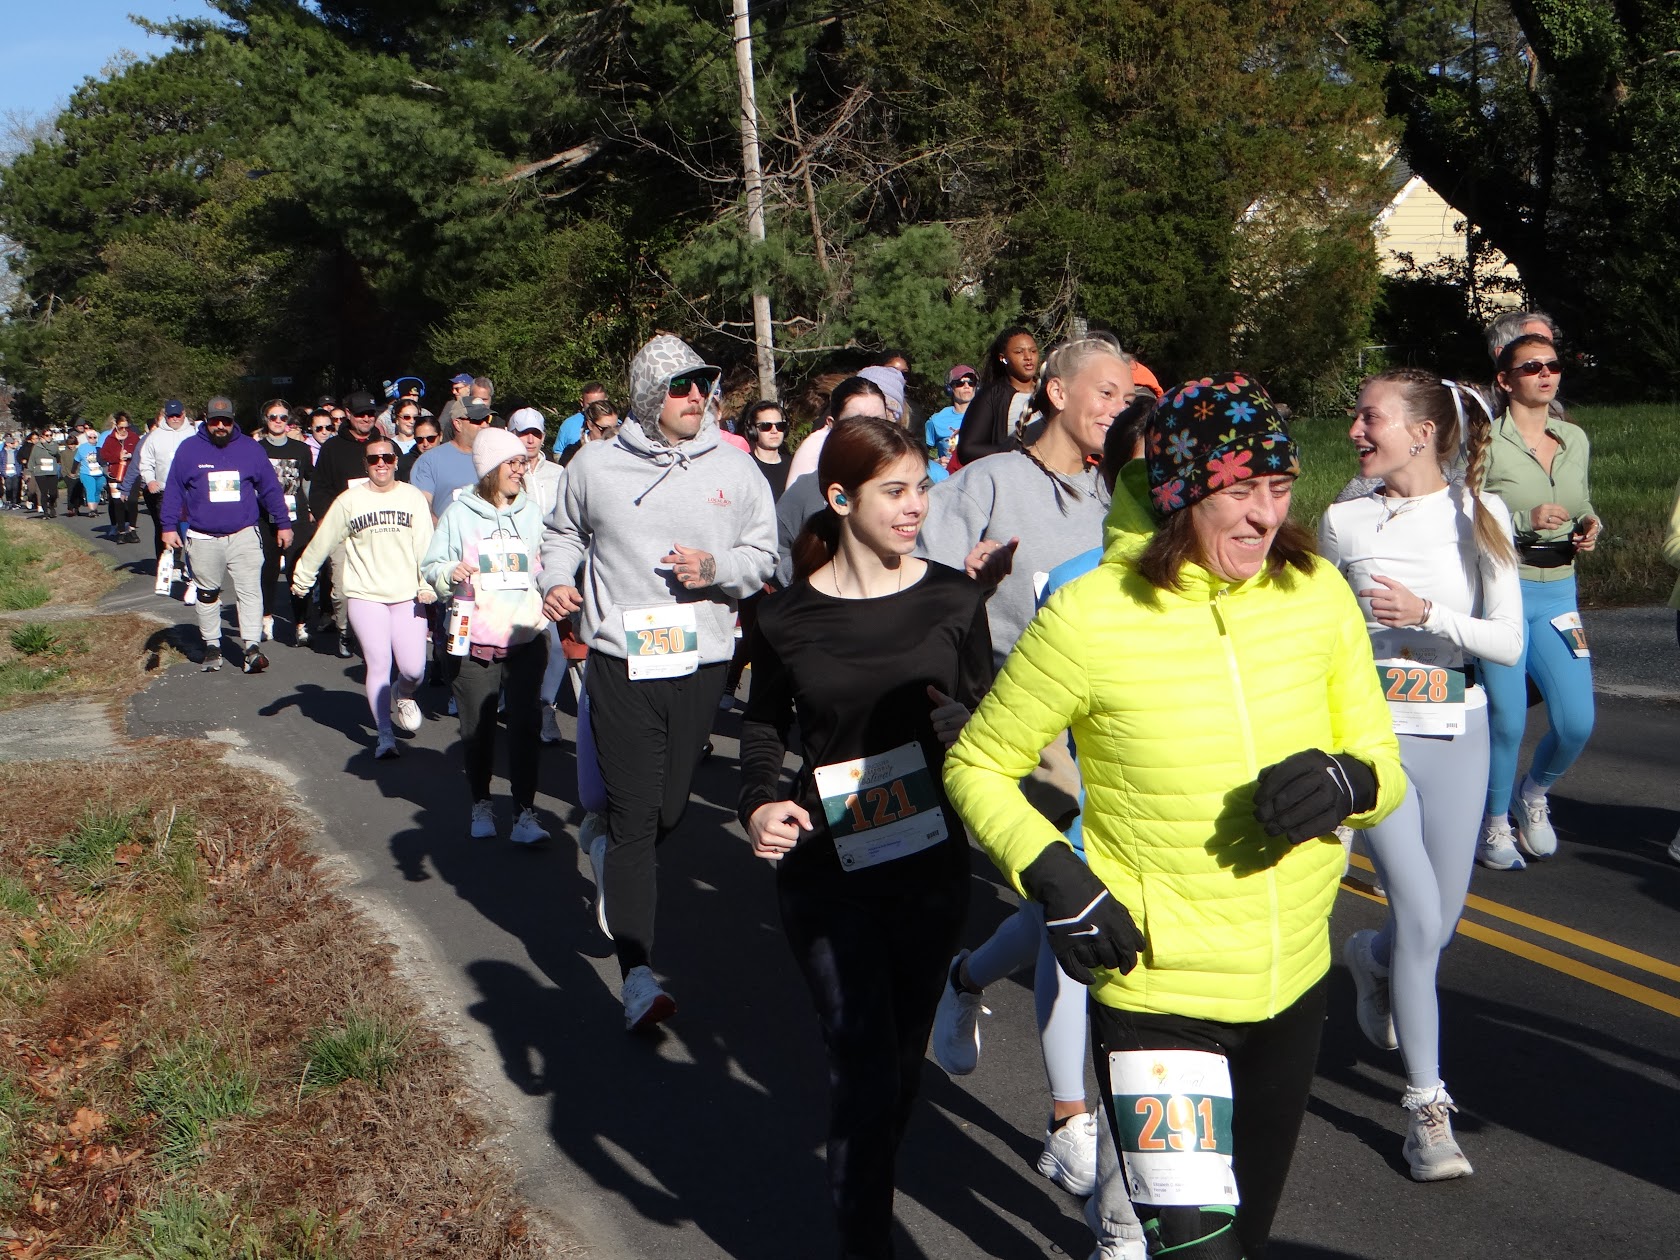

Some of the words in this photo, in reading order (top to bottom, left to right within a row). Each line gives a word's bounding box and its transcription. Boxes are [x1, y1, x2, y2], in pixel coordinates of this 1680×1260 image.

[350, 511, 379, 534] PANAMA
[379, 510, 396, 525] CITY
[637, 627, 685, 656] 250
[1385, 667, 1448, 703] 228
[844, 778, 918, 832] 121
[1134, 1095, 1217, 1151] 291
